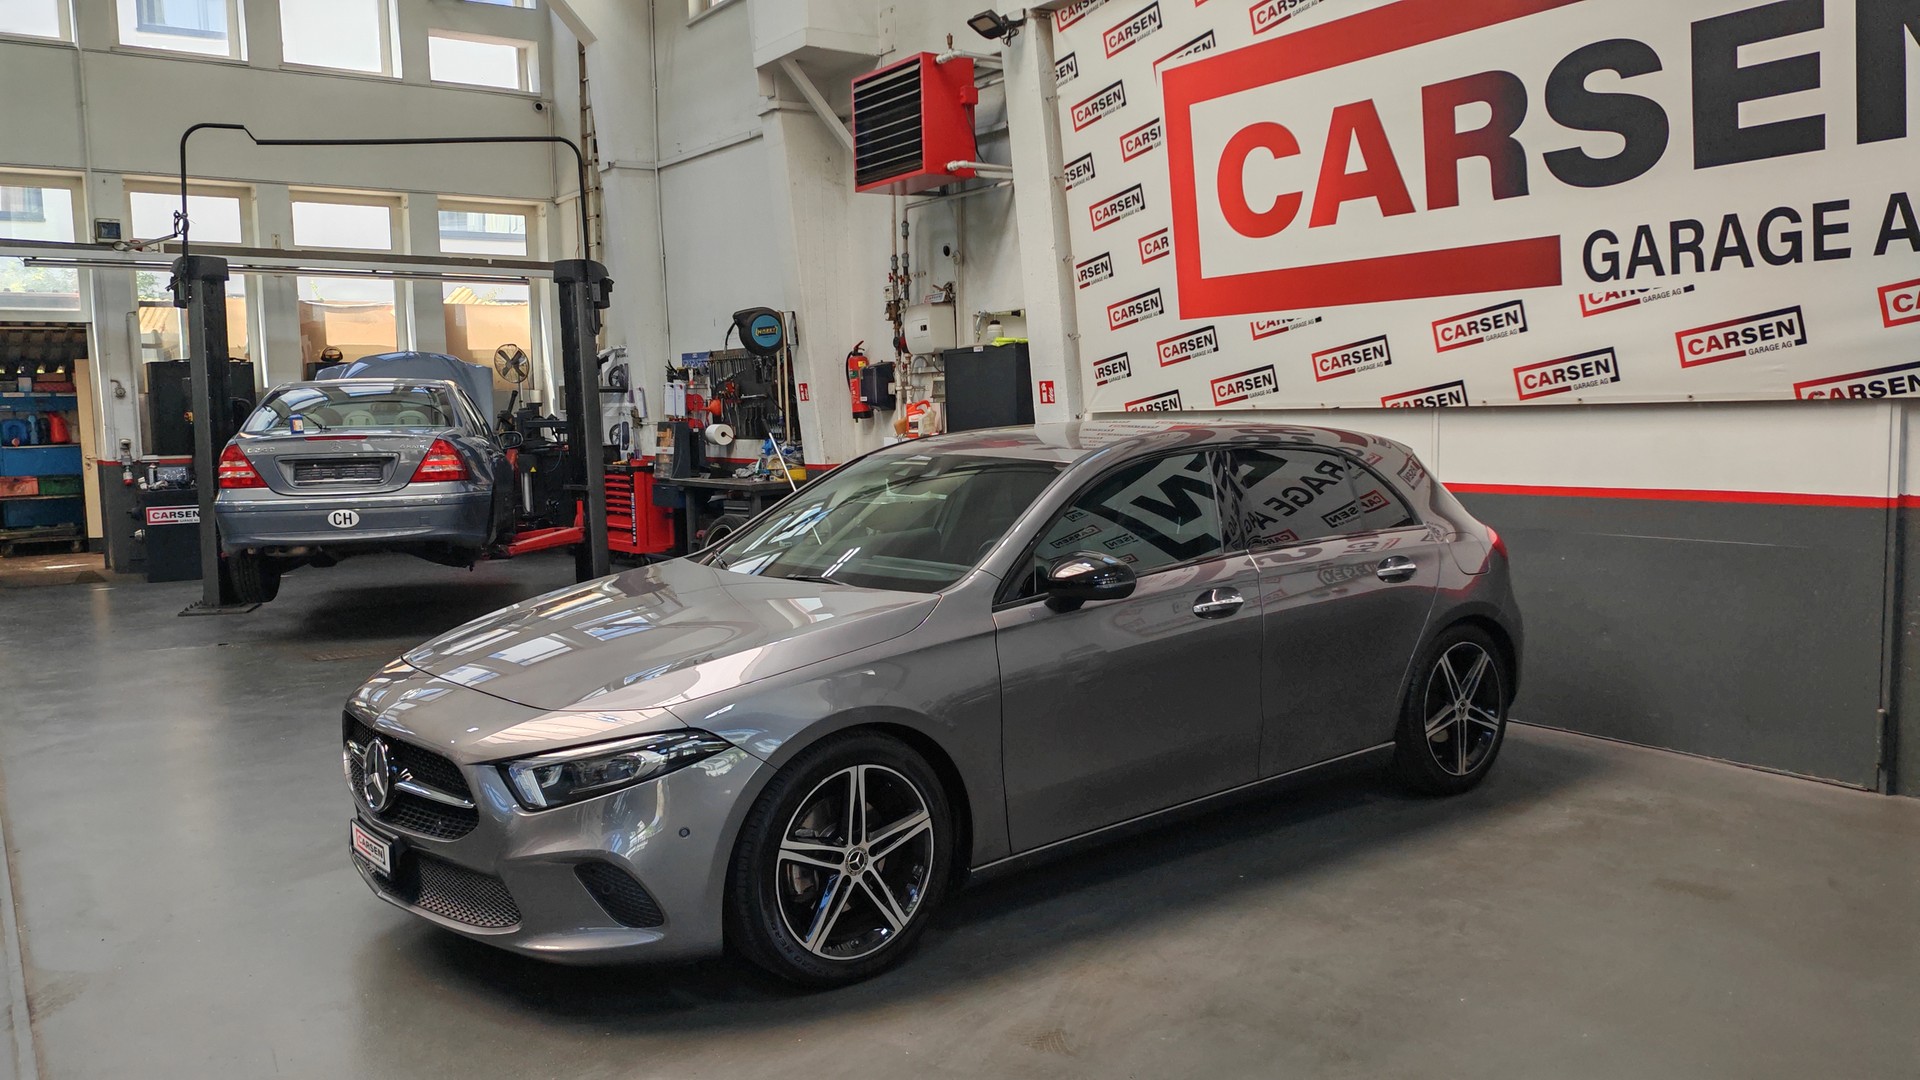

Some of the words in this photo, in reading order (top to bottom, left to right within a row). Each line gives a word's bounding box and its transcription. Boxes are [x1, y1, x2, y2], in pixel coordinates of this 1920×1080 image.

[1060, 0, 1096, 22] CARS
[1256, 0, 1304, 24] CARS
[1108, 10, 1157, 48] CARSEN
[1076, 89, 1122, 122] CARSEN
[1126, 125, 1161, 152] CARS
[1064, 161, 1091, 182] RSEN
[1095, 192, 1140, 222] CARSEN
[1144, 236, 1169, 255] CAR
[1582, 199, 1852, 283] GARAGE
[1873, 192, 1920, 256] A
[1077, 260, 1109, 282] RSEN
[1642, 291, 1671, 304] GARAGE
[1671, 288, 1682, 296] AG
[1112, 296, 1159, 322] CARSEN
[1441, 310, 1519, 342] CARSEN
[1485, 331, 1508, 342] GARAGE
[1509, 328, 1518, 336] AG
[1687, 318, 1796, 356] CARSEN
[1162, 333, 1213, 359] CARSEN
[1319, 344, 1385, 372] CARSEN
[1748, 343, 1780, 356] GARAGE
[1781, 340, 1793, 349] AG
[1094, 360, 1127, 379] RSEN
[1357, 363, 1376, 373] GARAGE
[1523, 358, 1610, 390] CARSEN
[1217, 373, 1273, 398] CARSEN
[1573, 380, 1599, 391] GARAGE
[1599, 378, 1609, 386] AG
[152, 511, 200, 519] CARSEN
[333, 512, 352, 526] CH
